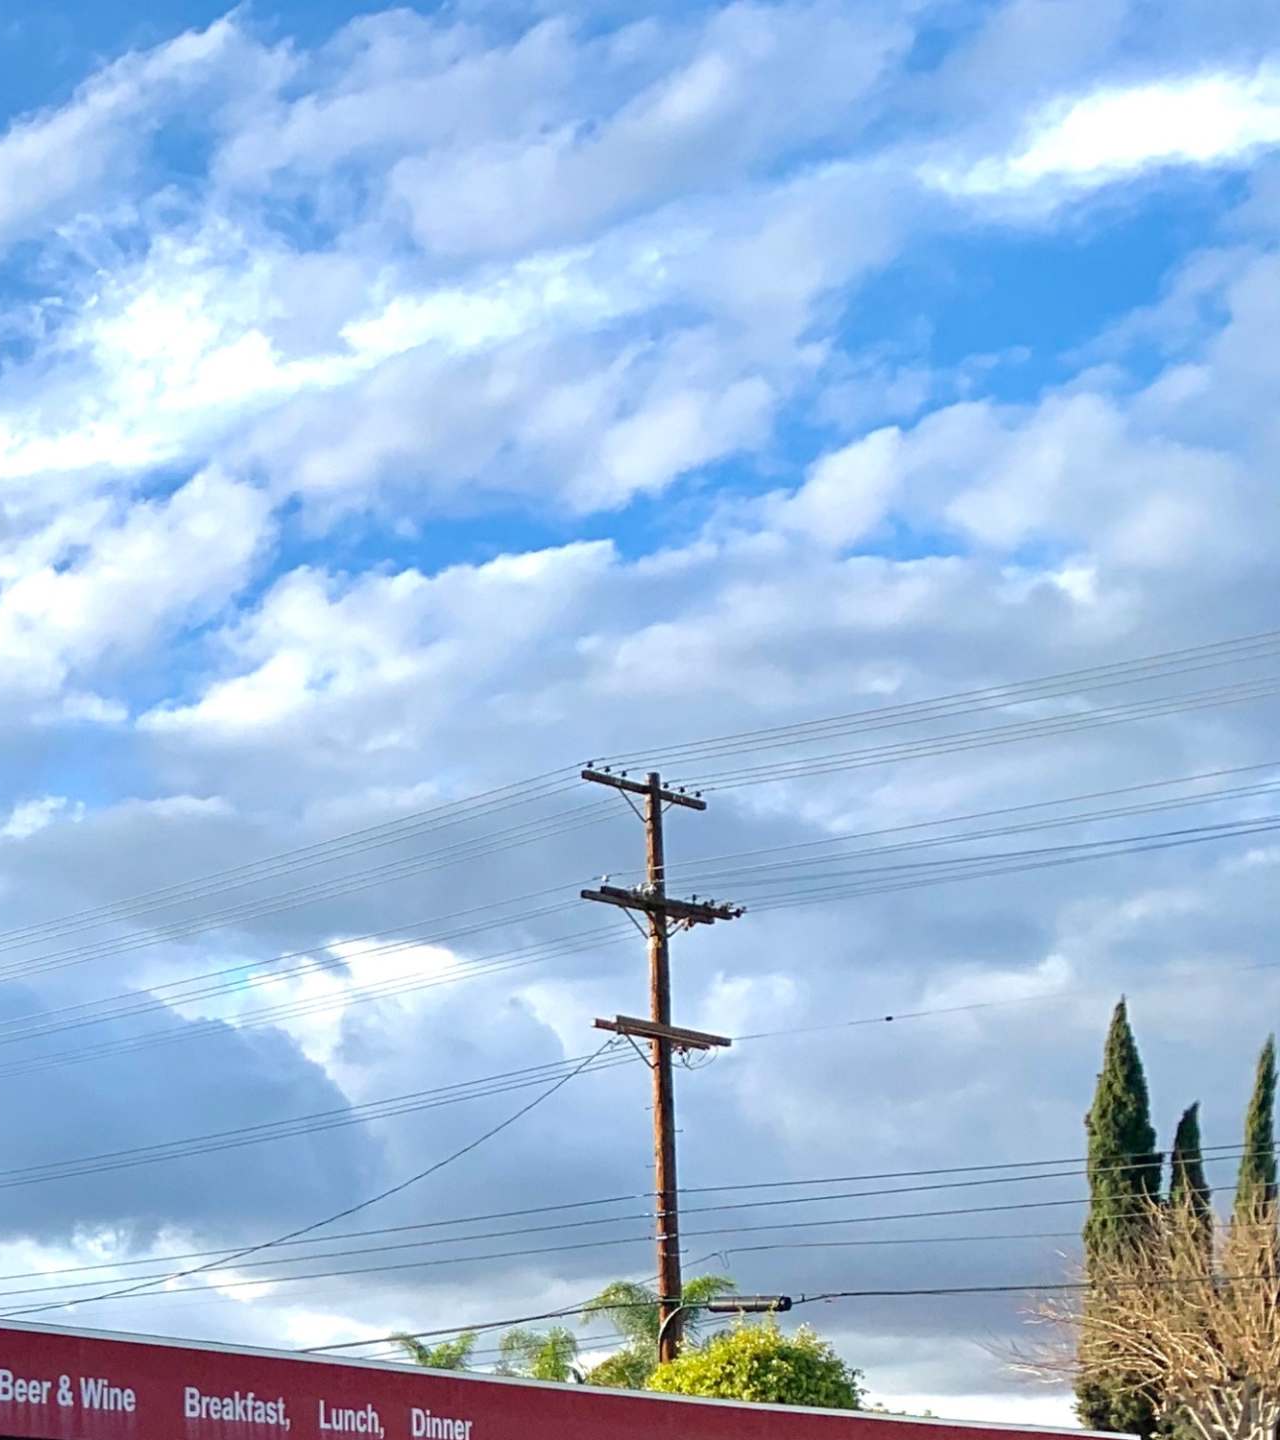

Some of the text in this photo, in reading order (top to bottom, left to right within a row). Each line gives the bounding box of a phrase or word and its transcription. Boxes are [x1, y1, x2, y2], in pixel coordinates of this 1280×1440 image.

[56, 1375, 74, 1407] &
[79, 1377, 136, 1412] Wine
[184, 1387, 291, 1431] Breakfast,
[319, 1400, 385, 1438] Lunch,
